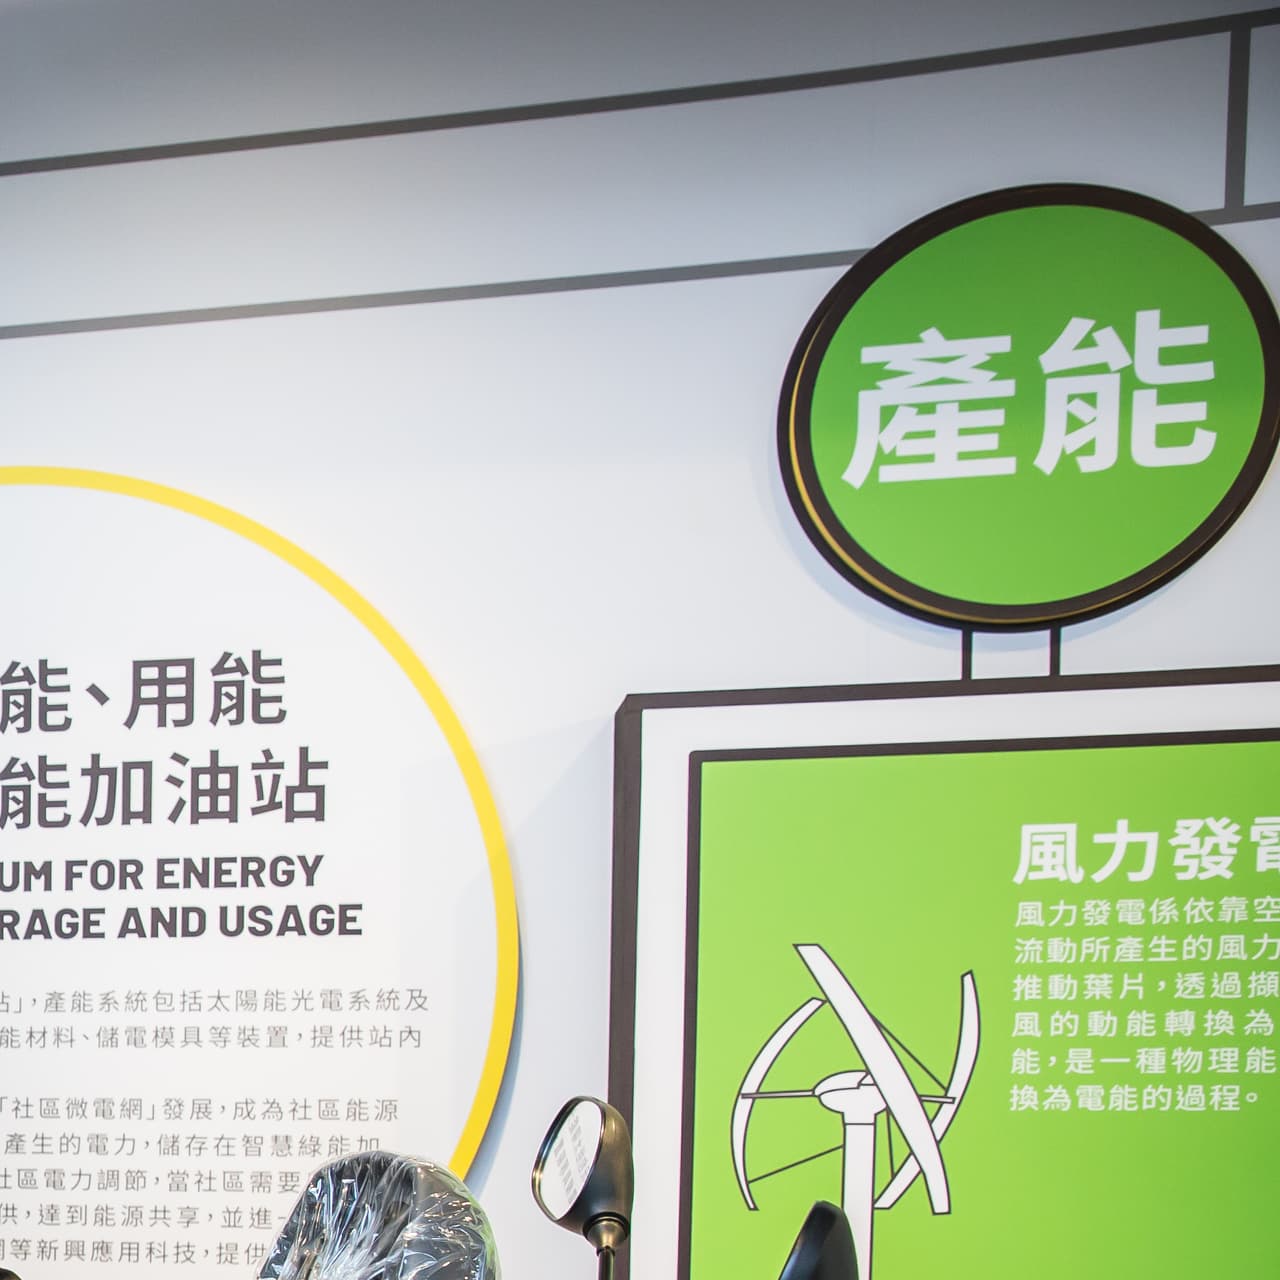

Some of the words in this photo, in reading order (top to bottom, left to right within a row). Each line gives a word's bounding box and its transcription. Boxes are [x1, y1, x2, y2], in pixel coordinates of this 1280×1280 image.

[841, 308, 1217, 490] 產能
[64, 857, 145, 892] FOR
[156, 854, 325, 890] ENERGY
[117, 906, 208, 939] AND
[218, 903, 363, 938] USAGE
